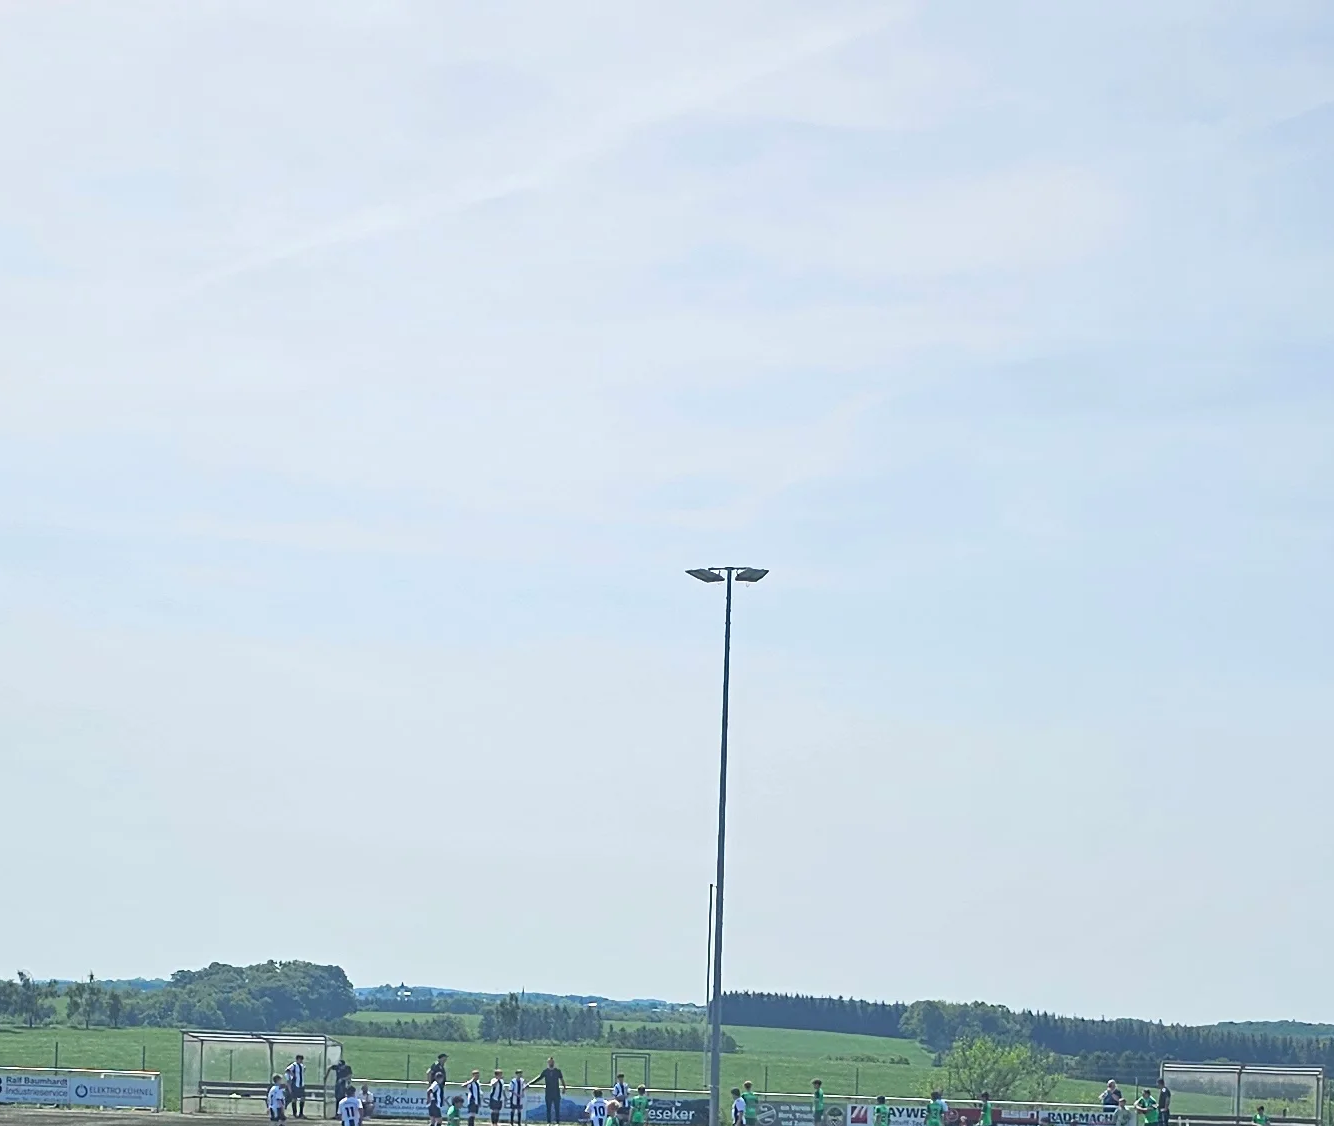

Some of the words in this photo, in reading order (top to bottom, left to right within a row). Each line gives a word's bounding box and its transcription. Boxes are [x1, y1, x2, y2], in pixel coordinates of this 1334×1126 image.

[6, 1076, 23, 1084] Ralf
[6, 1088, 68, 1097] Industrieservice
[89, 1086, 122, 1095] ELEKTRO
[122, 1087, 154, 1096] KÜHNEL
[344, 1106, 355, 1118] 11
[593, 1105, 606, 1117] 10
[648, 1106, 695, 1120] eseker
[886, 1107, 928, 1119] AYWE
[1047, 1112, 1114, 1123] RADEMACH
